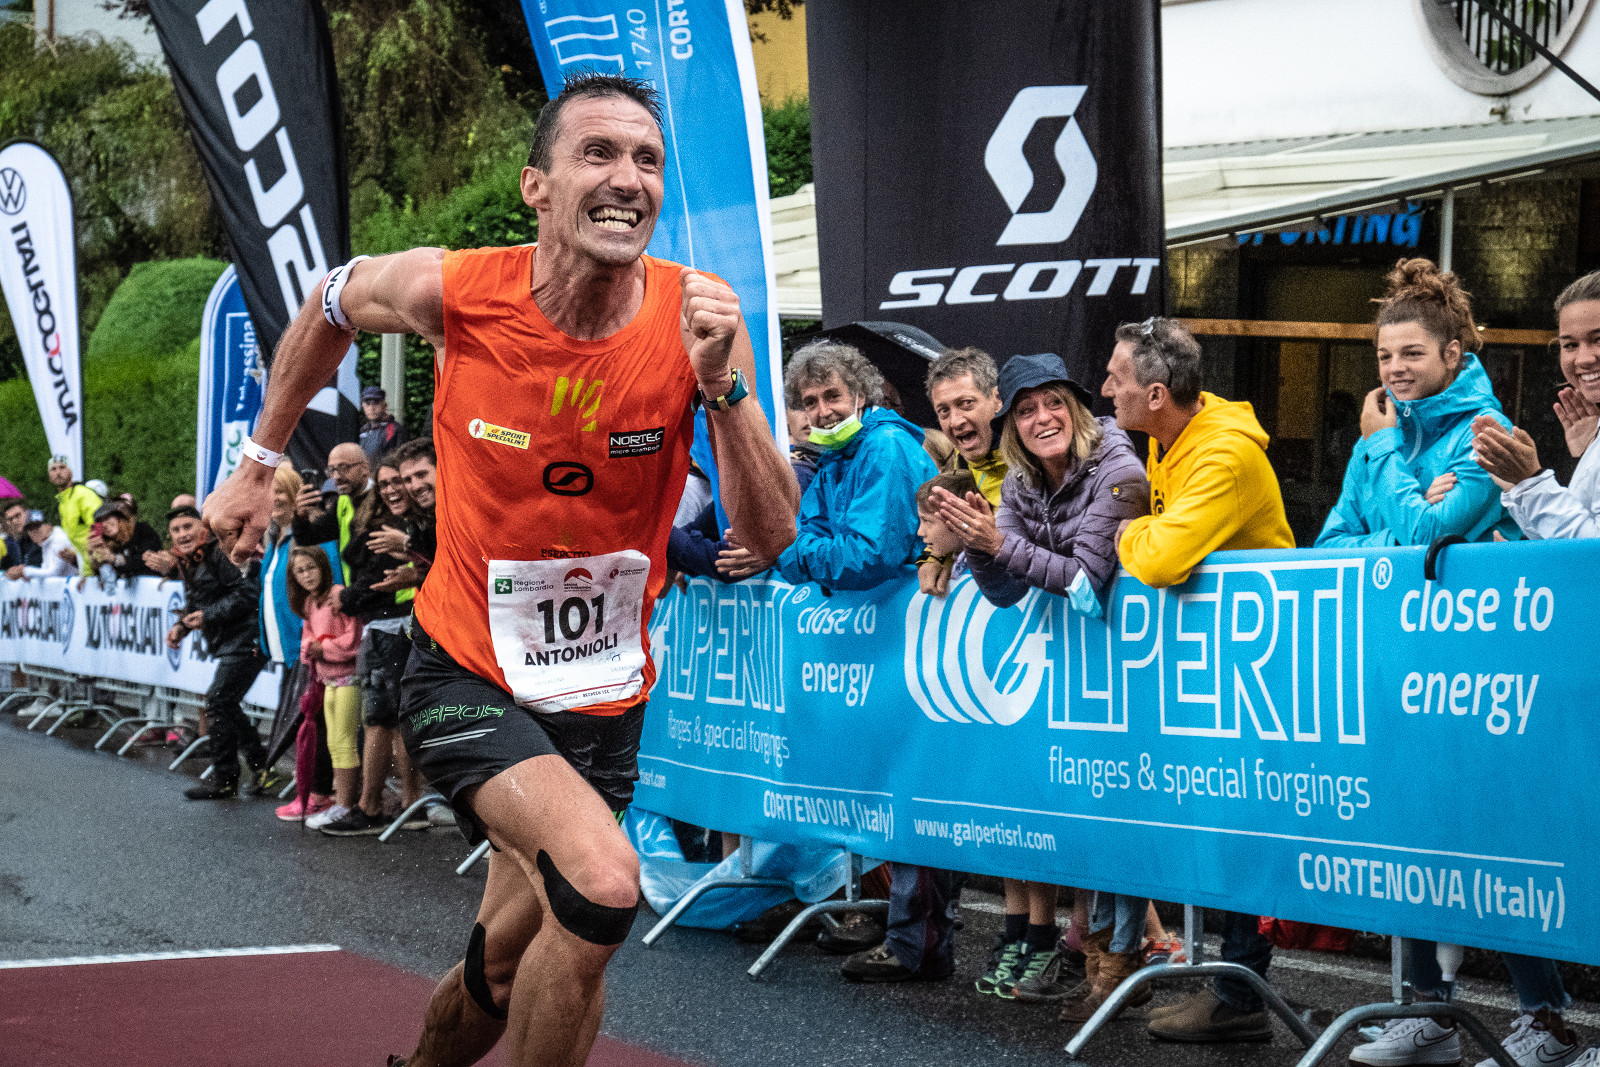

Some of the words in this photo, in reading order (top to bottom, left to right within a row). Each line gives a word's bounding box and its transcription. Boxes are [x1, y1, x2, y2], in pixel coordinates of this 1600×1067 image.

[626, 8, 653, 70] 1740
[879, 257, 1160, 310] SCOTT
[486, 432, 526, 446] SPECIALIST
[501, 430, 528, 441] SPORT
[610, 430, 664, 446] NORTEC
[541, 548, 592, 558] ESERCITO
[514, 584, 554, 592] Lombardia
[1400, 578, 1500, 632] close
[1513, 576, 1555, 633] to
[537, 592, 605, 644] 101
[797, 600, 849, 635] close
[854, 600, 876, 635] to
[524, 633, 618, 666] ANTONIOLI
[802, 662, 874, 707] energy
[1401, 670, 1540, 736] energy
[704, 719, 747, 754] special
[1048, 745, 1130, 799] flanges
[1137, 752, 1157, 791] &
[1162, 755, 1247, 805] special
[1253, 757, 1371, 821] forgings
[763, 789, 851, 828] CORTENOVA
[851, 798, 894, 842] (Italy)
[914, 814, 1057, 852] www.galpertisrl.com
[1298, 852, 1466, 910] CORTENOVA
[1474, 868, 1566, 933] (Italy)
